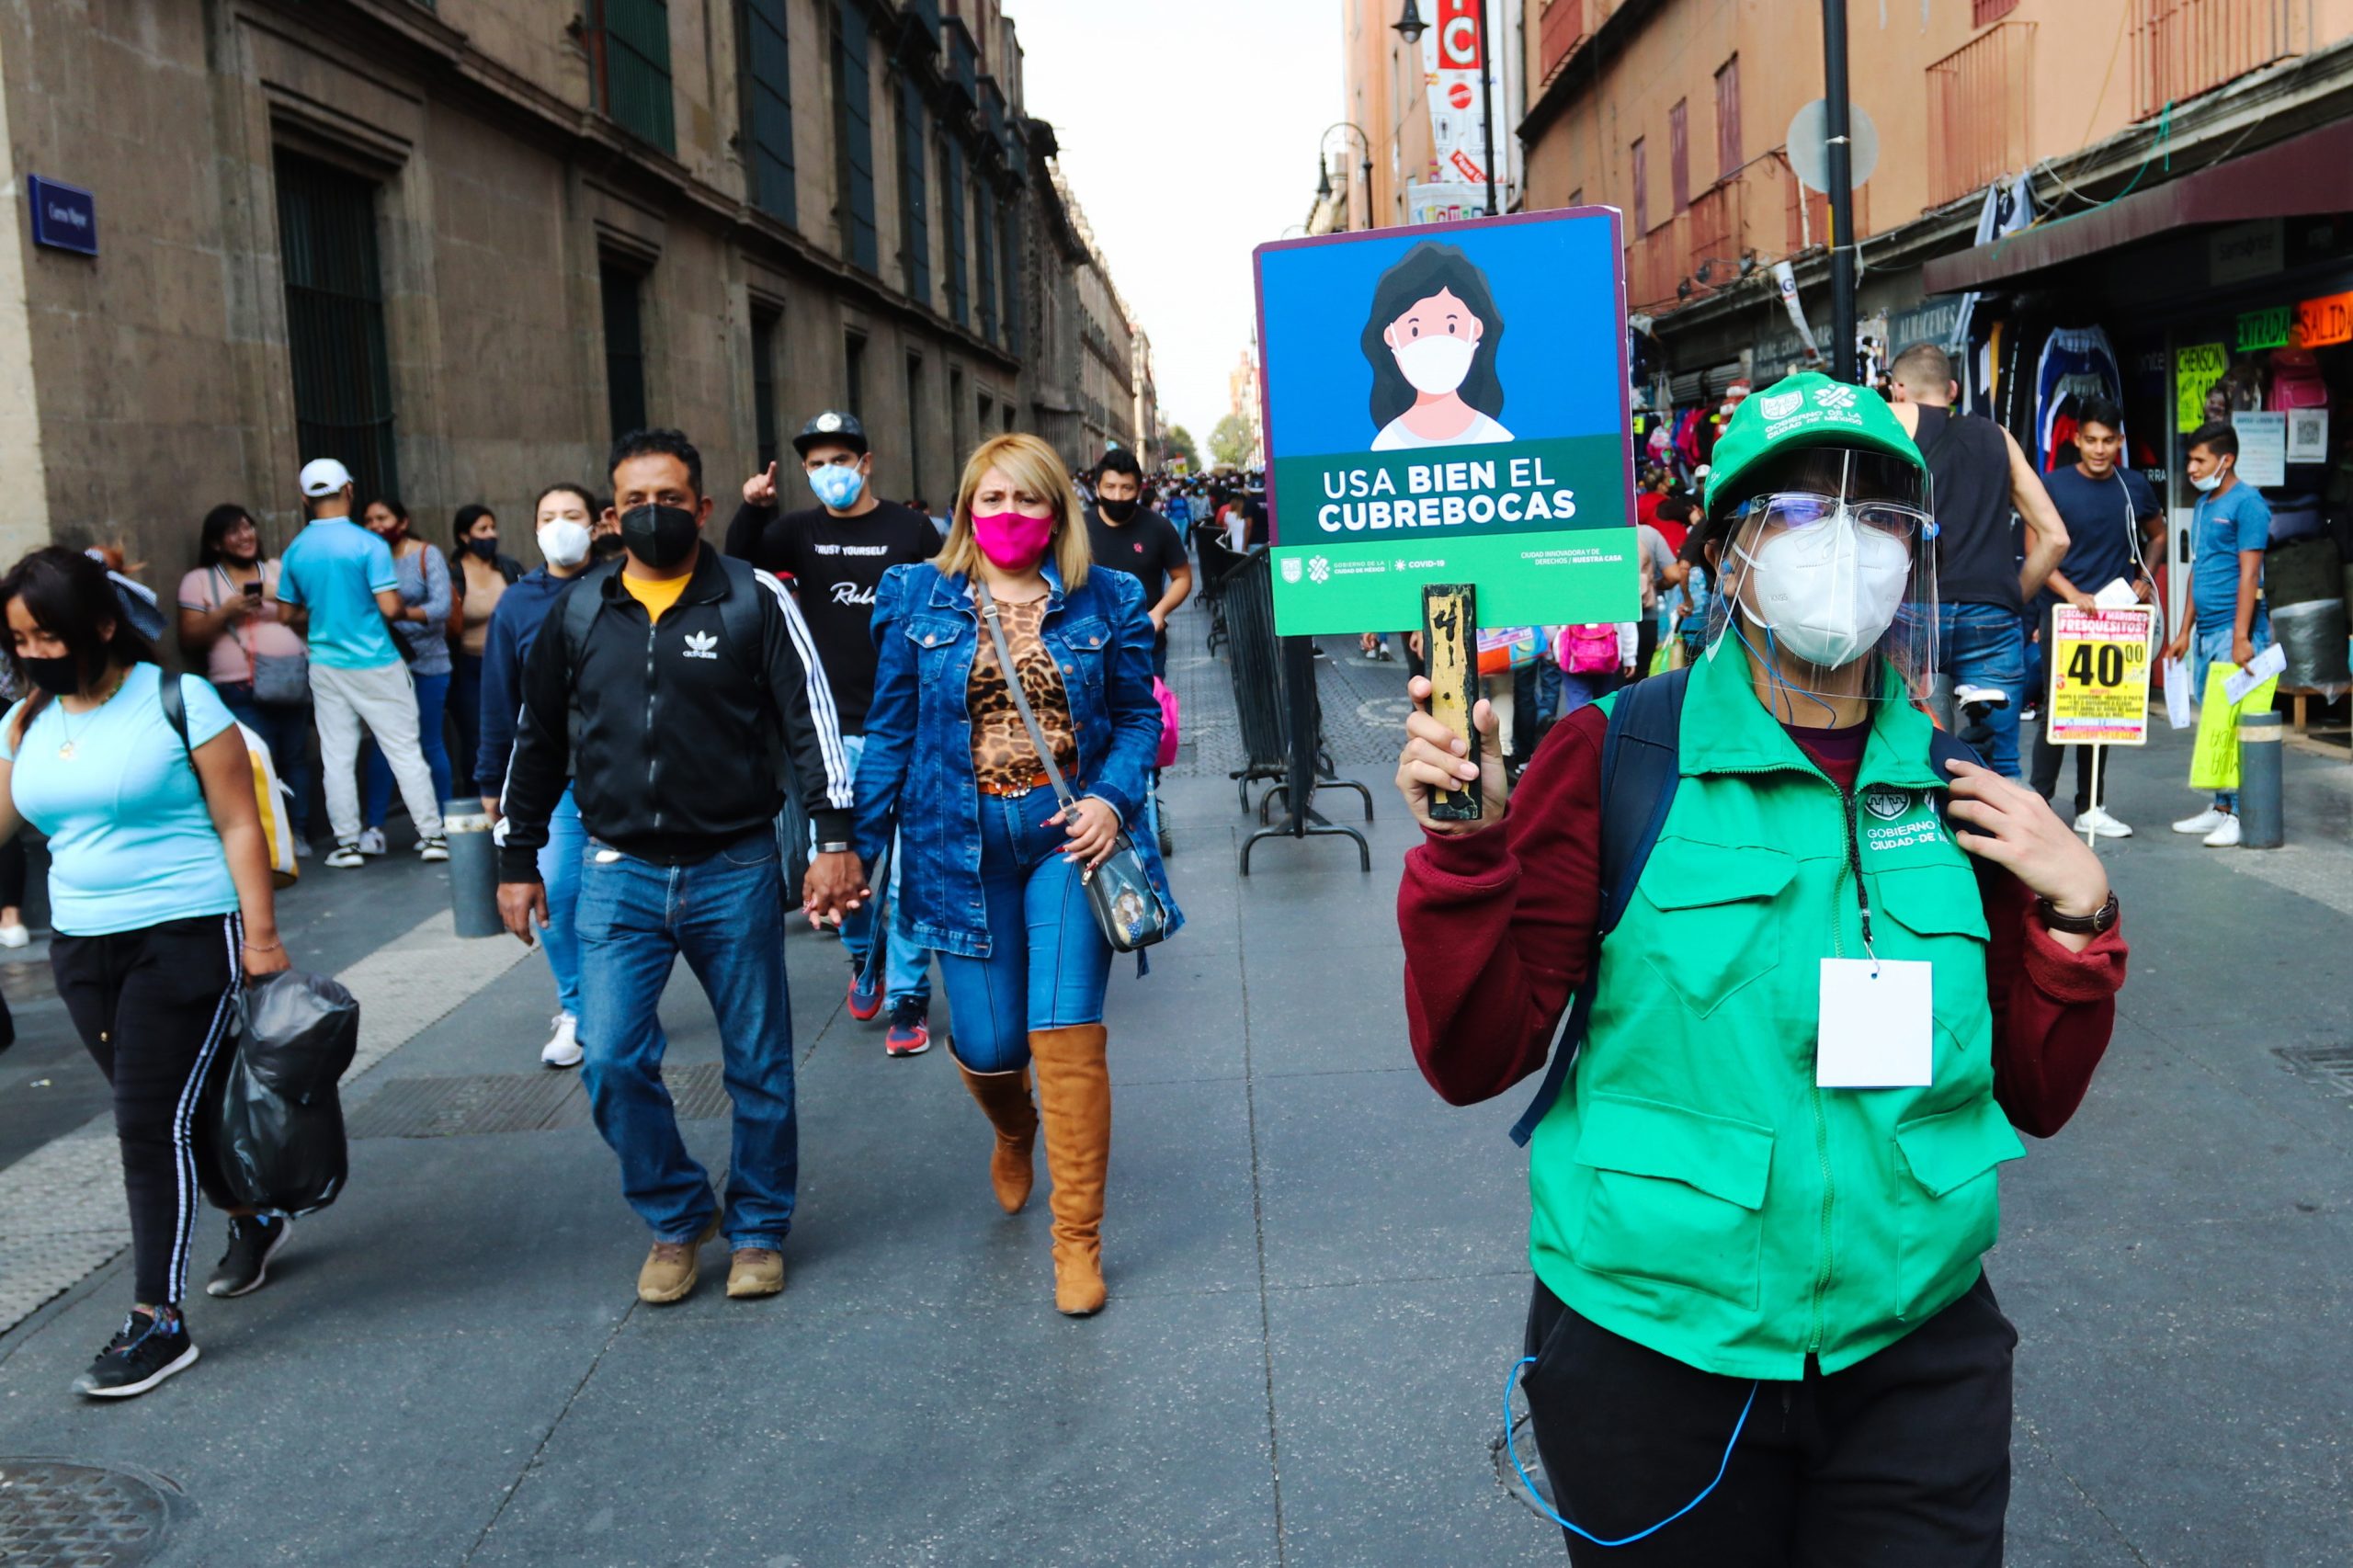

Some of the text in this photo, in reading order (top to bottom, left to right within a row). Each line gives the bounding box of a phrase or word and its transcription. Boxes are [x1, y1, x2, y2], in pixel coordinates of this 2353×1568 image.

[1443, 0, 1474, 64] C
[2237, 311, 2288, 347] ENTRADA
[1765, 409, 1861, 433] GOBIERNO DE LA
[1767, 421, 1802, 439] CIUDAD
[1323, 457, 1555, 499] USA BIEN EL
[1317, 489, 1576, 532] CUBREBOCAS
[814, 543, 888, 556] TRUST YOURSELF
[1408, 560, 1445, 569] COVID-19
[683, 649, 717, 659] adidas
[2068, 644, 2123, 687] 40
[2125, 644, 2143, 663] 00
[1867, 820, 1936, 838] GOBIERNO
[1870, 837, 1914, 851] CIUDAD
[1919, 832, 1936, 843] DE
